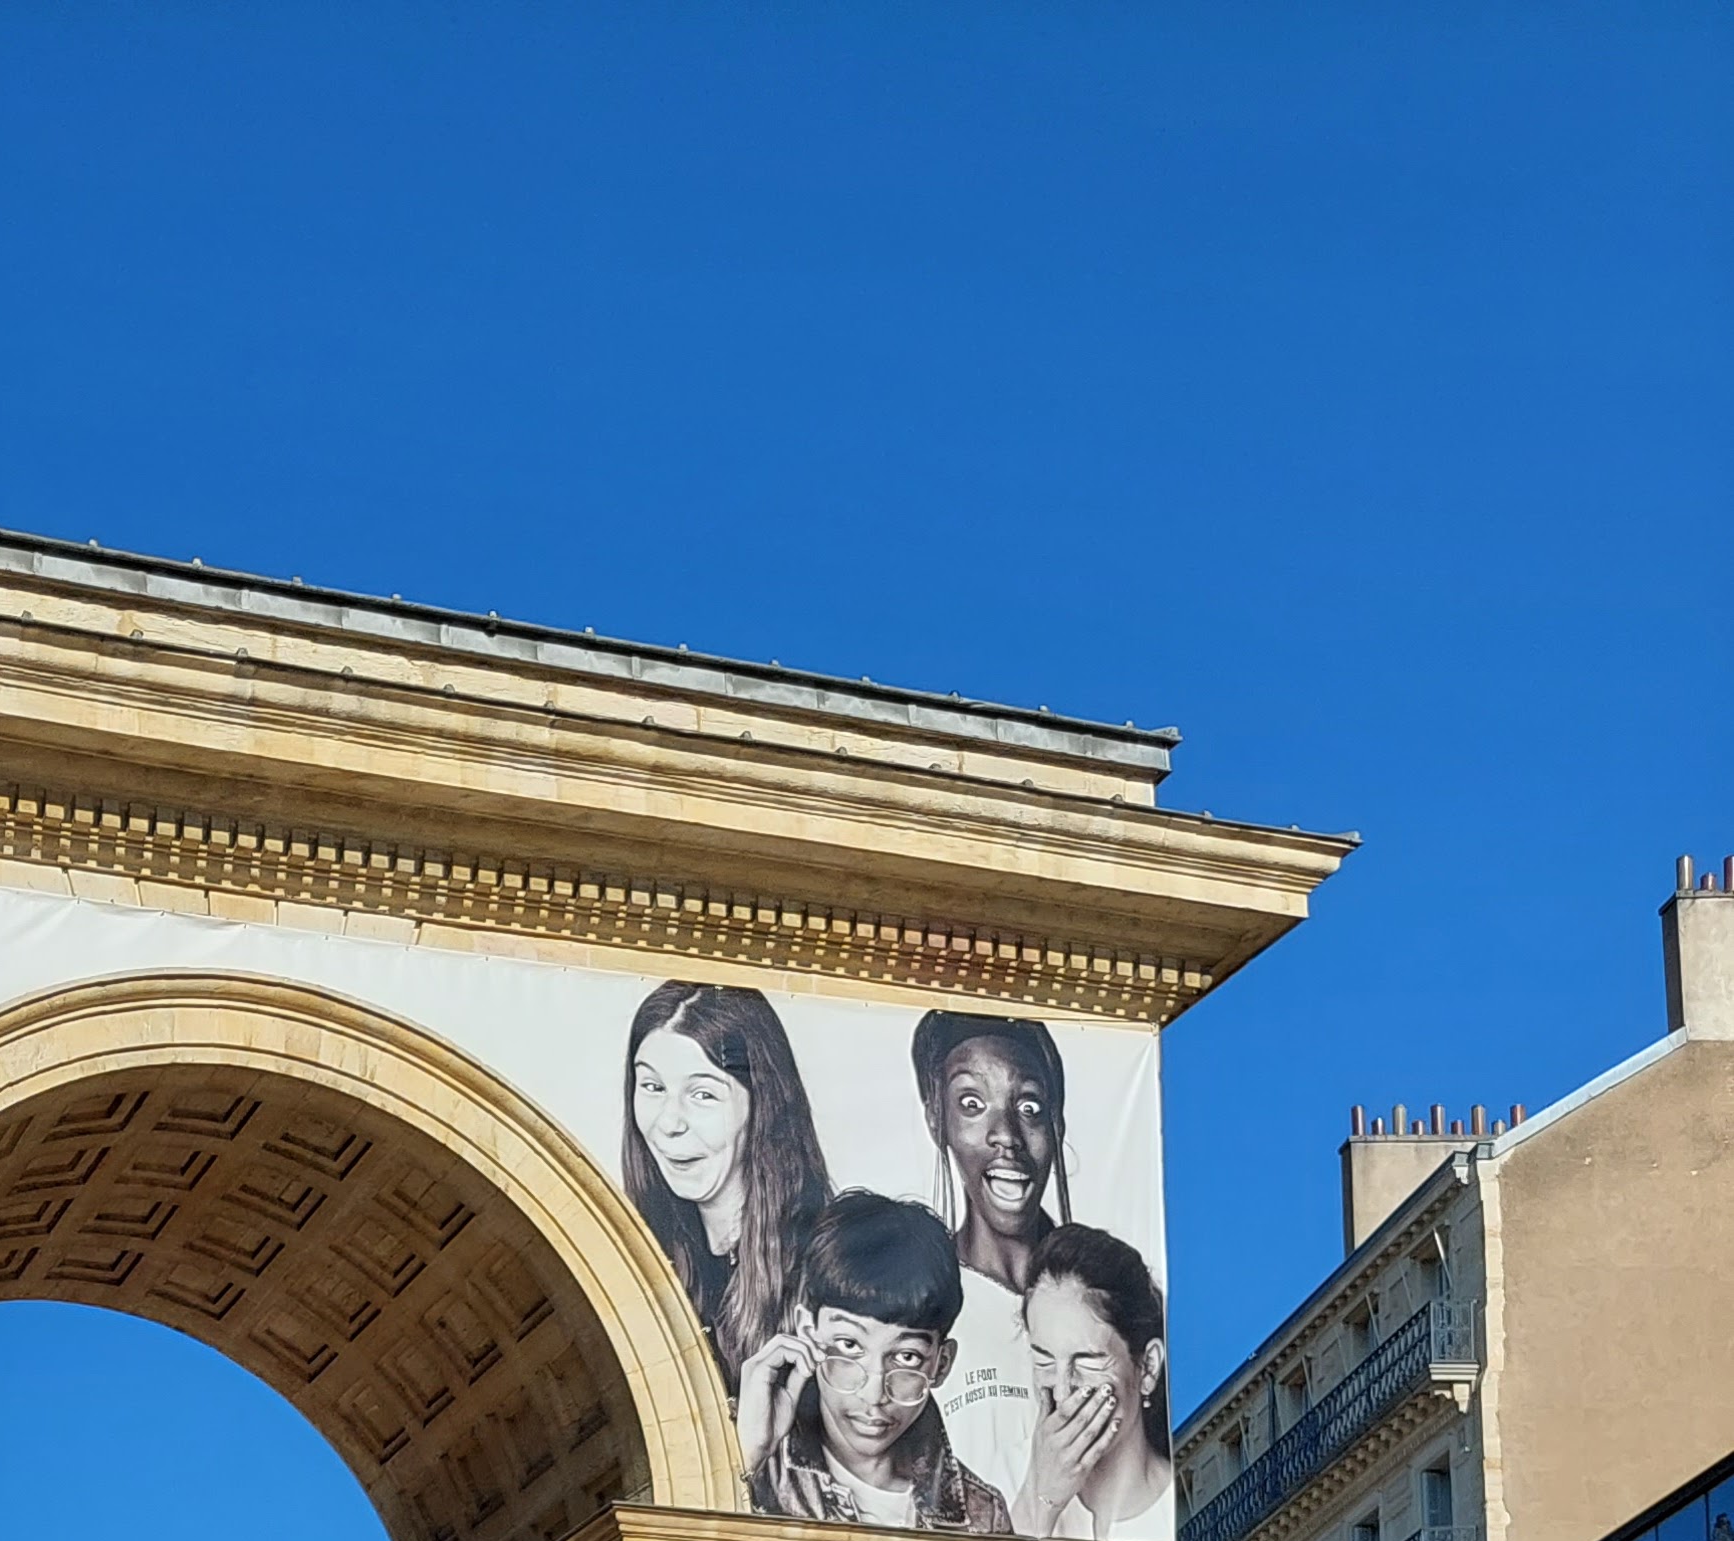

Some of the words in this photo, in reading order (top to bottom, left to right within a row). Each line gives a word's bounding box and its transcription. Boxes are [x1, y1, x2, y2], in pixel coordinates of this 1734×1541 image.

[965, 1371, 975, 1386] LE
[977, 1367, 998, 1382] FOOT
[965, 1386, 986, 1406] AUSSI
